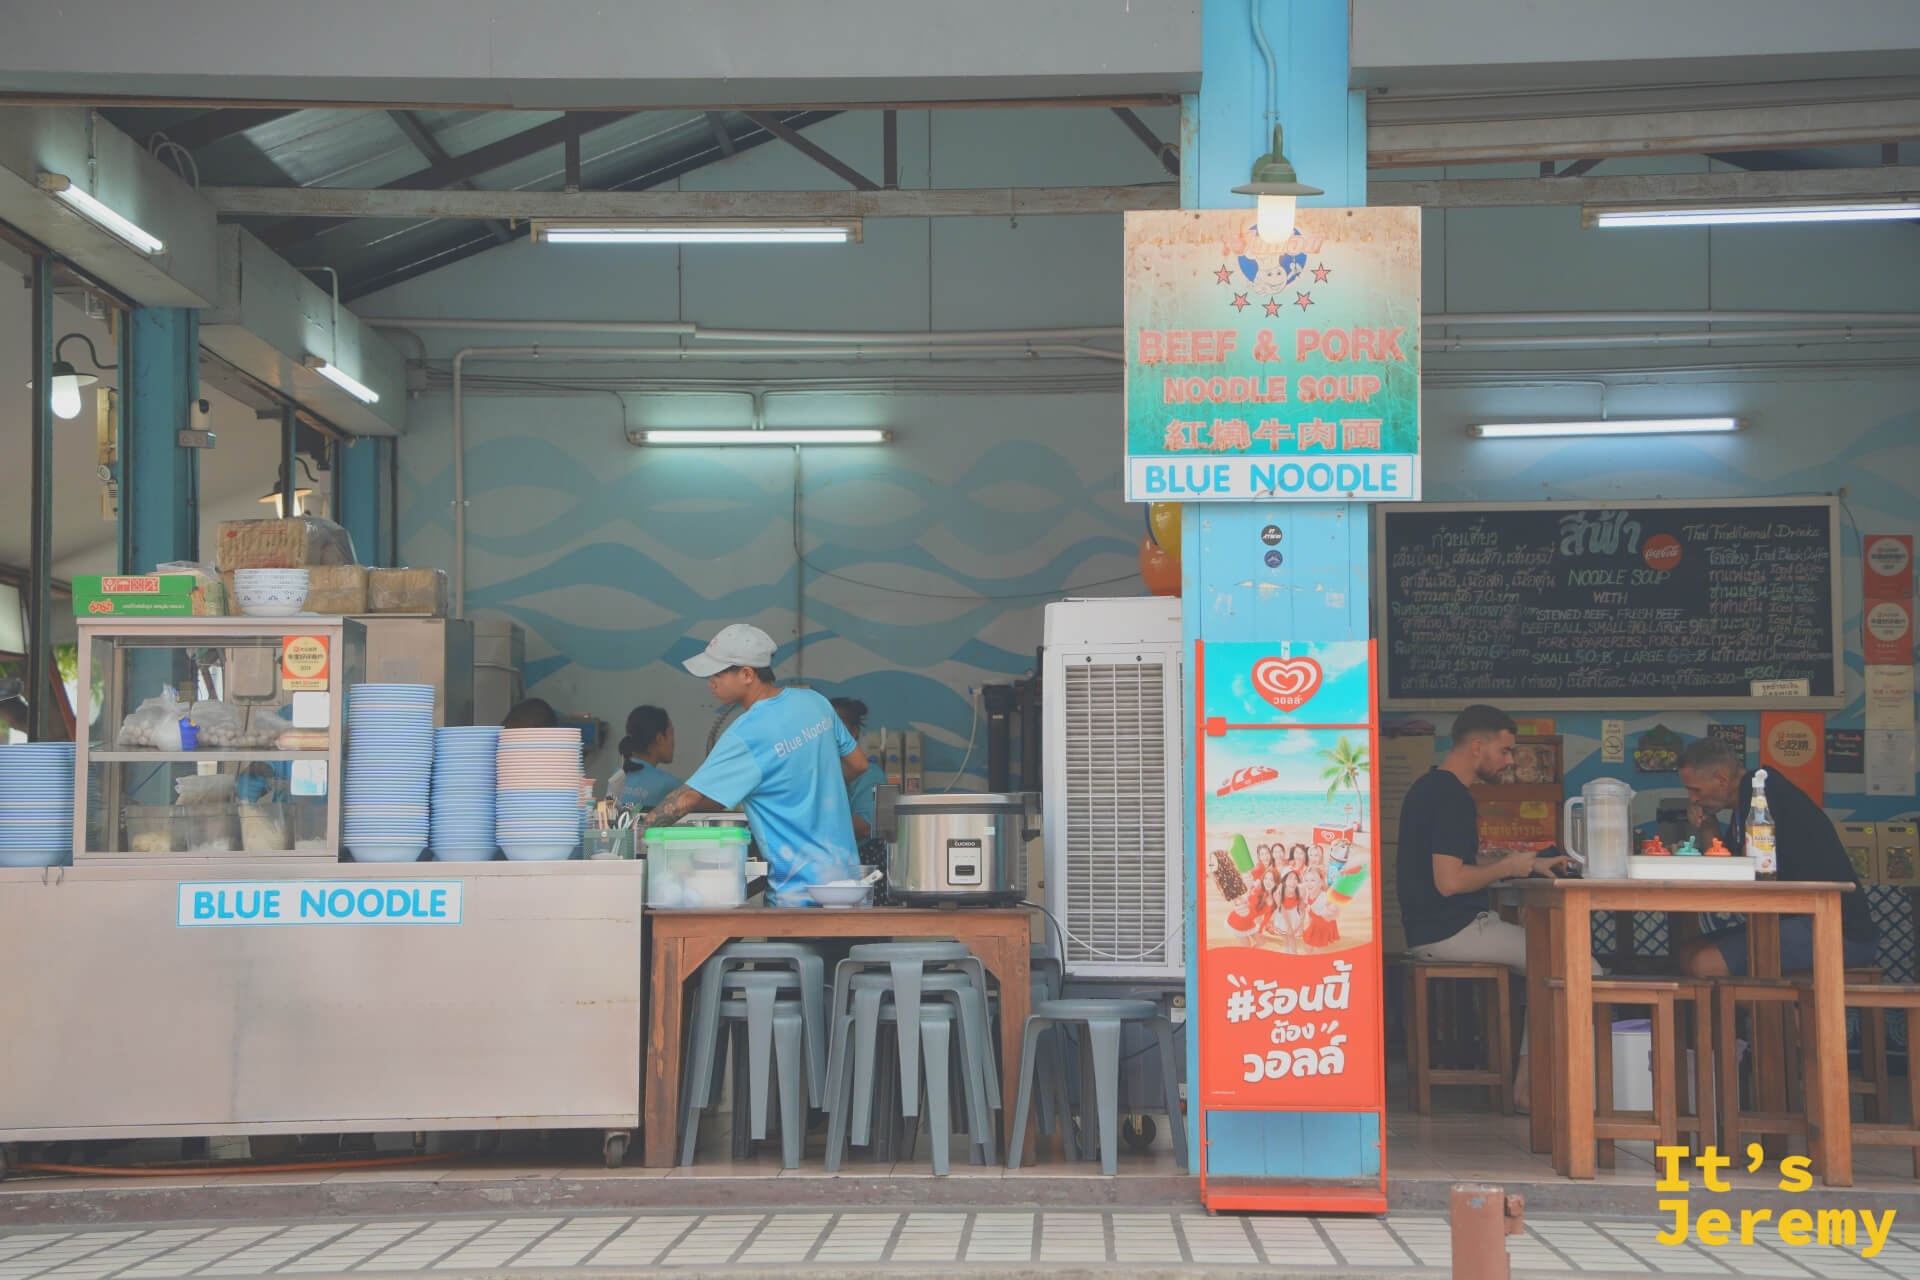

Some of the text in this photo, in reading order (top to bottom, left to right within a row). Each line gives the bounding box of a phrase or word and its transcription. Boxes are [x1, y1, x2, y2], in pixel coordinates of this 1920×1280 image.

[1138, 327, 1406, 364] BEEF & PORK
[1164, 375, 1381, 404] NOODLE SOUP
[1145, 462, 1397, 493] BLUE NOODLE
[1567, 569, 1672, 587] NOODLE SOUP
[1593, 592, 1628, 604] WITH
[1536, 609, 1581, 621] STEWED
[1531, 652, 1573, 664] SMALL
[1623, 650, 1664, 664] LARGE
[774, 736, 803, 758] Blue
[194, 889, 447, 919] BLUE NOODLE
[1270, 1020, 1316, 1044] ต้อง
[1243, 1034, 1348, 1083] วอลล์
